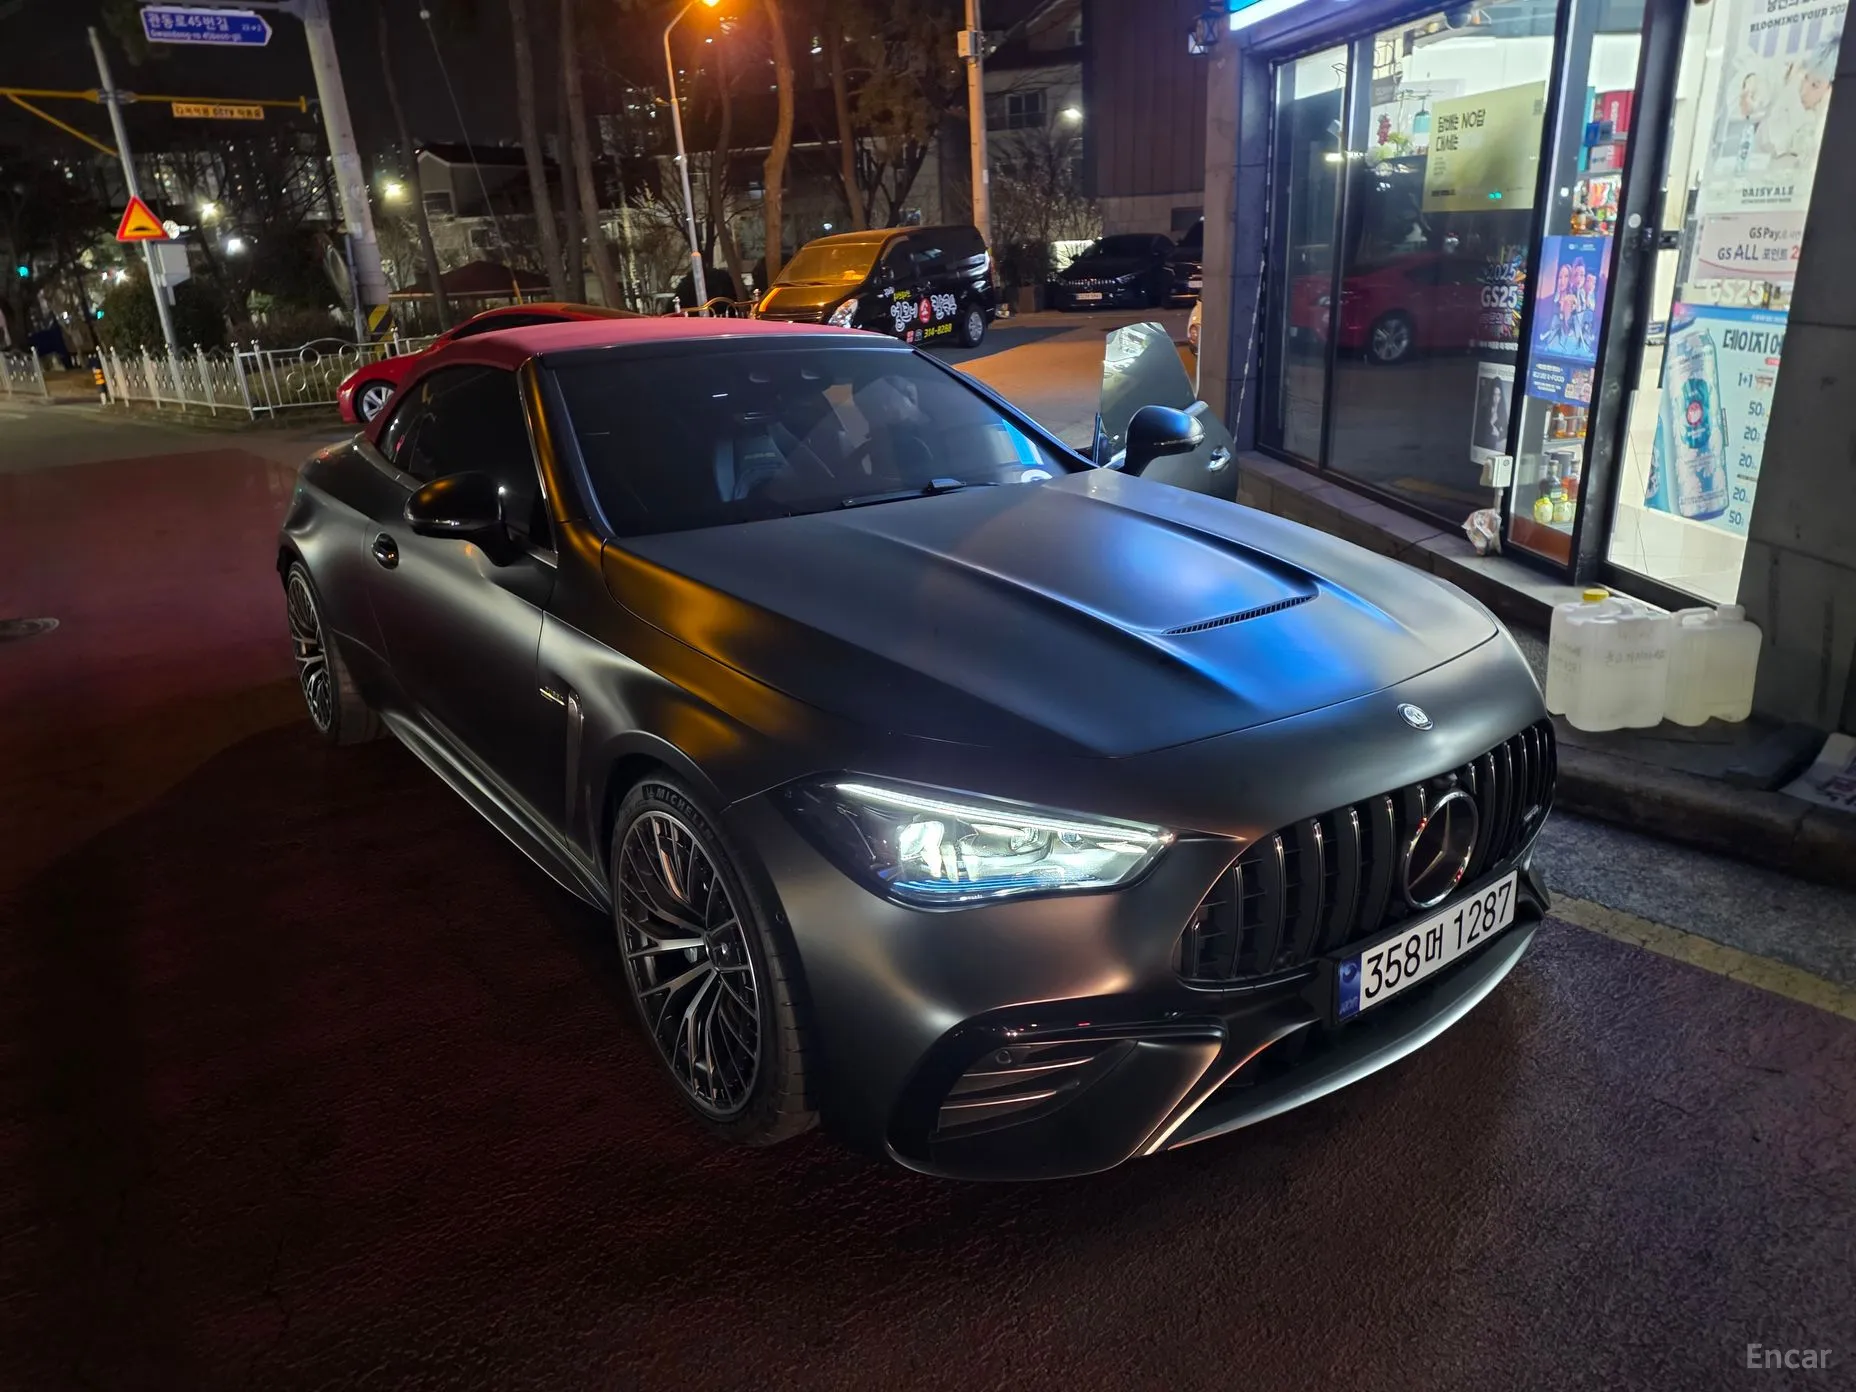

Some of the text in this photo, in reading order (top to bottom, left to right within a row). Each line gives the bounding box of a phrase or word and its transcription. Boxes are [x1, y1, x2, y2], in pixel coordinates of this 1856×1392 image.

[148, 13, 229, 31] 관동로45번길
[1461, 108, 1486, 129] NO답
[1717, 247, 1732, 260] GS
[1733, 244, 1759, 261] ALL
[1482, 285, 1518, 308] GS25
[656, 787, 714, 842] MICHELIN
[1365, 880, 1512, 999] 358머 1287
